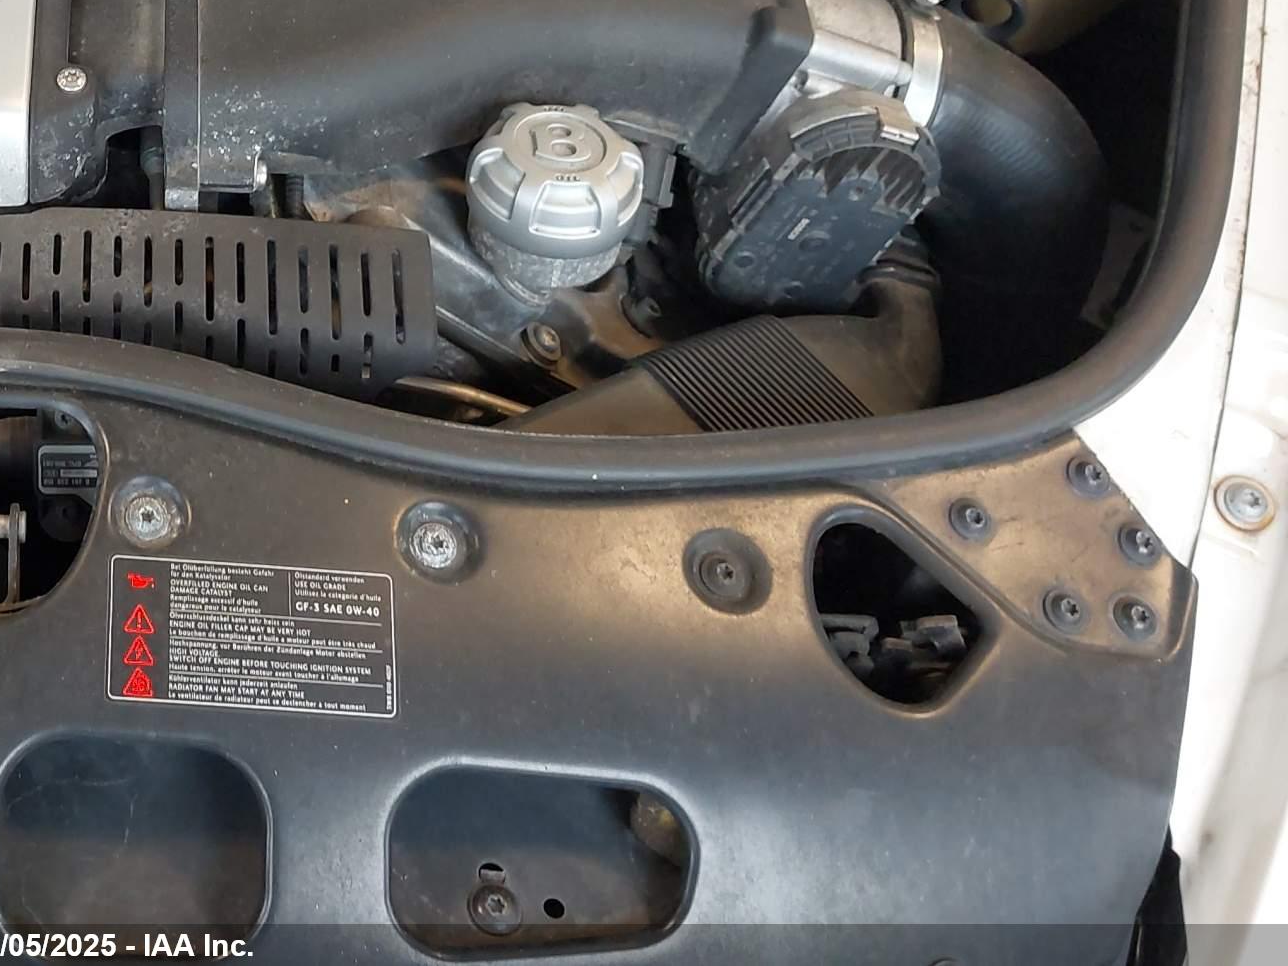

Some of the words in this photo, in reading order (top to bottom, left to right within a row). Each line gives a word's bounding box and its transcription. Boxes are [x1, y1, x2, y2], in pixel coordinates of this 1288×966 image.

[170, 578, 209, 588] OVERFILLED
[211, 581, 236, 590] ENGINE
[239, 583, 250, 591] OIL
[253, 584, 268, 592] CAN
[170, 585, 197, 594] DAMAGE
[201, 587, 231, 596] CATALYST
[294, 580, 307, 588] USE
[309, 581, 320, 589] OIL
[323, 582, 345, 590] GRADE
[295, 601, 319, 612] GF-3
[323, 603, 342, 614] SAE
[346, 604, 379, 616] 0W-40
[169, 619, 194, 628] ENGINE
[197, 621, 208, 629] OIL
[211, 622, 232, 631] FILLER
[234, 624, 247, 632] CAP
[250, 625, 264, 633] MAY
[277, 627, 294, 635] VERY
[296, 628, 311, 636] HOT
[169, 654, 196, 663] SWITCH
[198, 656, 211, 664] OFF
[213, 657, 239, 666] ENGINE
[242, 659, 267, 668] BEFORE
[270, 661, 307, 670] TOUCHING
[310, 663, 342, 672] IGNITION
[345, 666, 370, 674] SYSTEM
[169, 682, 202, 691] RADIATOR
[221, 686, 235, 694] MAY
[237, 687, 257, 695] START
[271, 689, 285, 697] ANY
[288, 690, 304, 698] TIME
